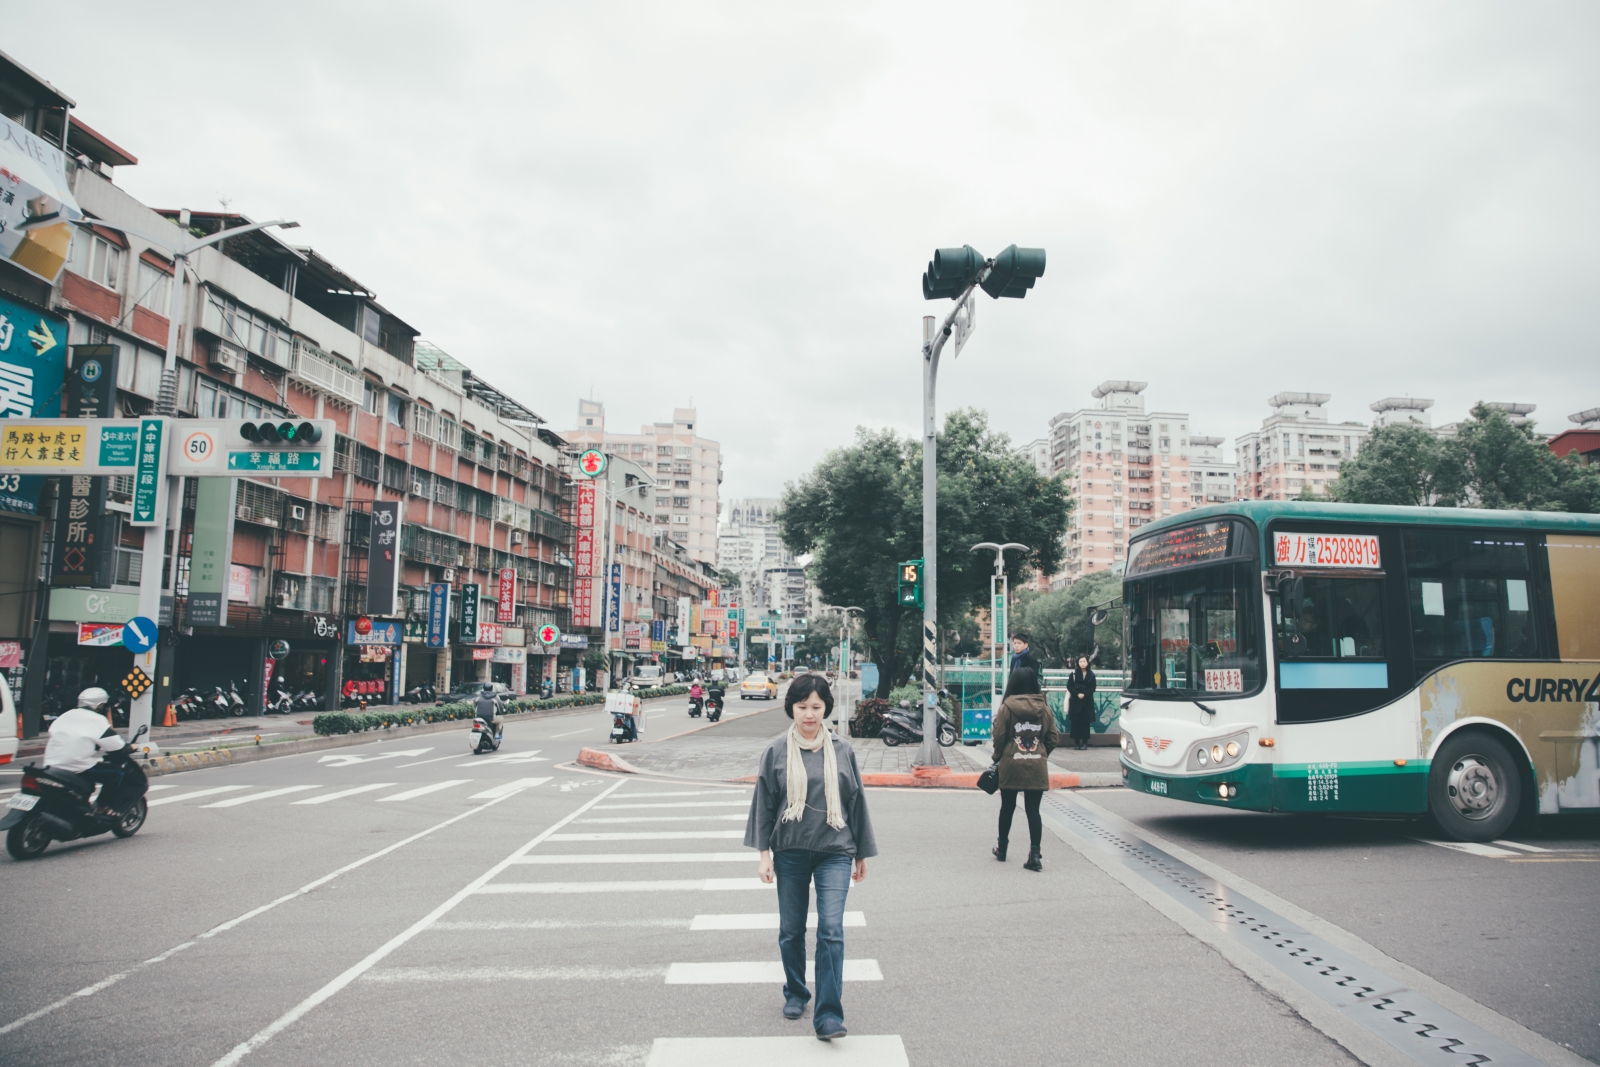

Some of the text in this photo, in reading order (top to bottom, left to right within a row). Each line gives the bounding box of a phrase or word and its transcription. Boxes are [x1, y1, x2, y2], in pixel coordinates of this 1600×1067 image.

[7, 431, 81, 444] 馬路如虎口
[5, 447, 80, 461] 行人靠邊走
[190, 440, 207, 453] 50
[141, 433, 156, 485] 中華路二段
[250, 452, 299, 465] 幸福路
[1276, 535, 1306, 563] 強力
[1317, 537, 1379, 565] 25288919
[905, 566, 916, 582] 15
[465, 586, 475, 635] 中山高爾夫
